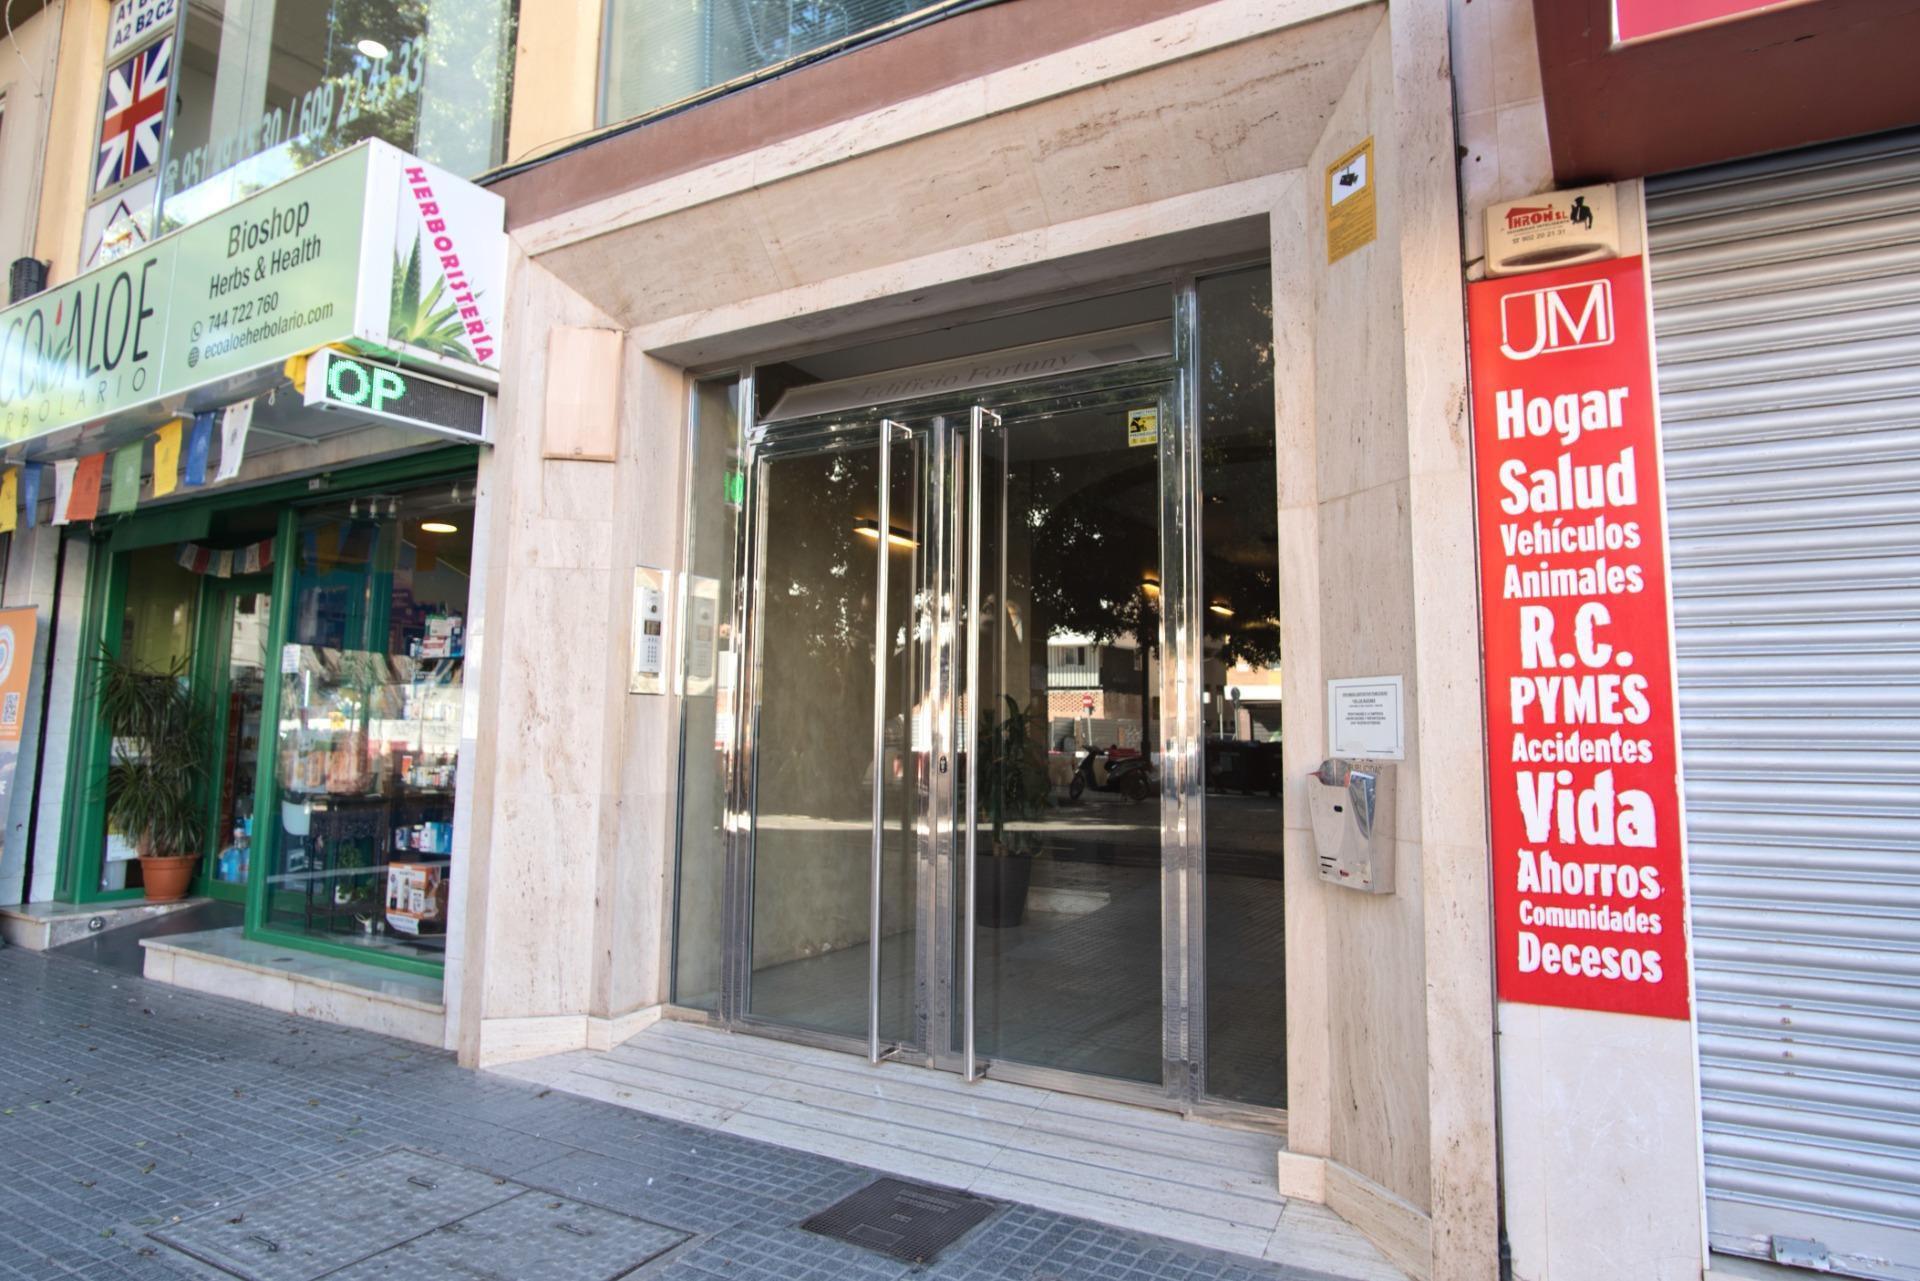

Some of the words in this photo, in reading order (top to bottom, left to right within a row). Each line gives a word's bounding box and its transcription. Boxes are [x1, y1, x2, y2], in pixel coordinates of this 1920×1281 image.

[113, 24, 131, 48] A2
[136, 9, 154, 33] B2
[156, 0, 174, 20] C2
[227, 201, 310, 258] Bioshop
[209, 266, 250, 299] Herbs
[254, 256, 266, 282] &
[270, 234, 321, 276] Health
[405, 166, 494, 364] HERBORISTERÍA
[204, 302, 334, 360] ecoaloeherbolario.com
[208, 310, 228, 334] 744
[232, 301, 253, 326] 722
[257, 291, 279, 316] 760
[1500, 282, 1608, 360] JM
[327, 359, 407, 412] OP
[860, 373, 959, 400] Edificio
[967, 352, 1078, 383] Fortuny
[1496, 387, 1629, 446] Hogar
[1499, 446, 1637, 515] Salud
[1500, 515, 1641, 557] Vehículos
[1503, 557, 1644, 599] Animales
[1520, 602, 1634, 669] R.C.
[1510, 674, 1650, 725] PYMES
[1512, 730, 1653, 764] Accidentes
[1516, 767, 1657, 848] Vida
[1517, 848, 1661, 899] Ahorros
[1519, 900, 1662, 934] Comunidades
[1518, 931, 1663, 984] Decesos
